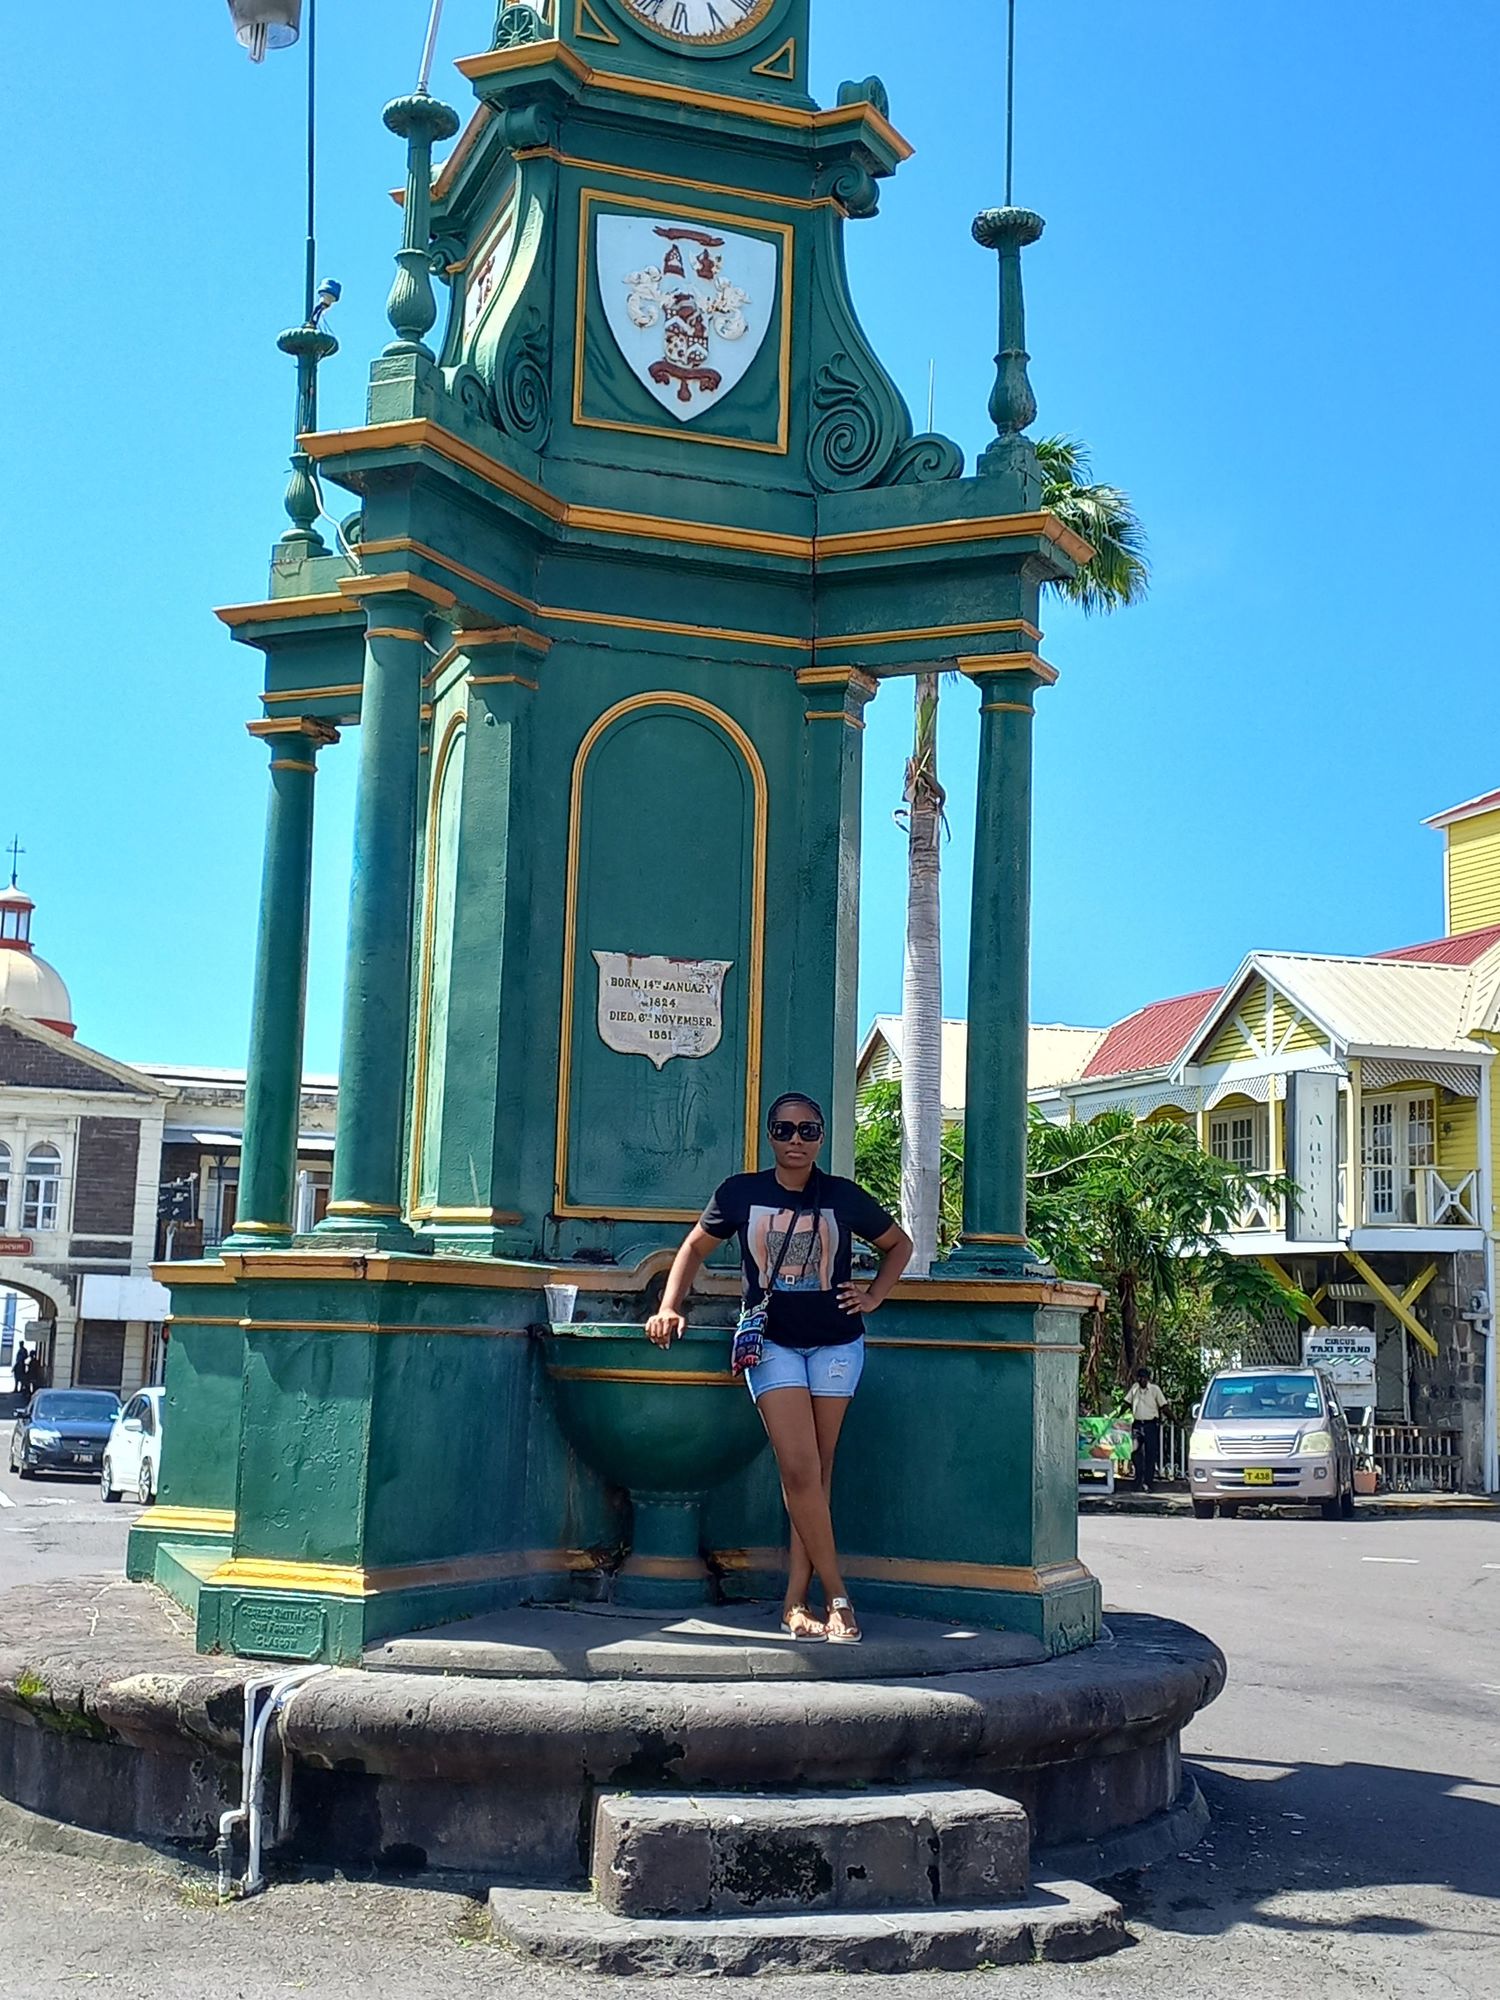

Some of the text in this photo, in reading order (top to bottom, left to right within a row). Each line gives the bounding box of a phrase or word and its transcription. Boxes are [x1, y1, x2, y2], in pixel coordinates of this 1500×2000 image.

[610, 976, 641, 989] BORN,
[662, 981, 713, 994] JANUARY
[609, 1010, 636, 1023] DIED,
[1246, 1472, 1253, 1481] T
